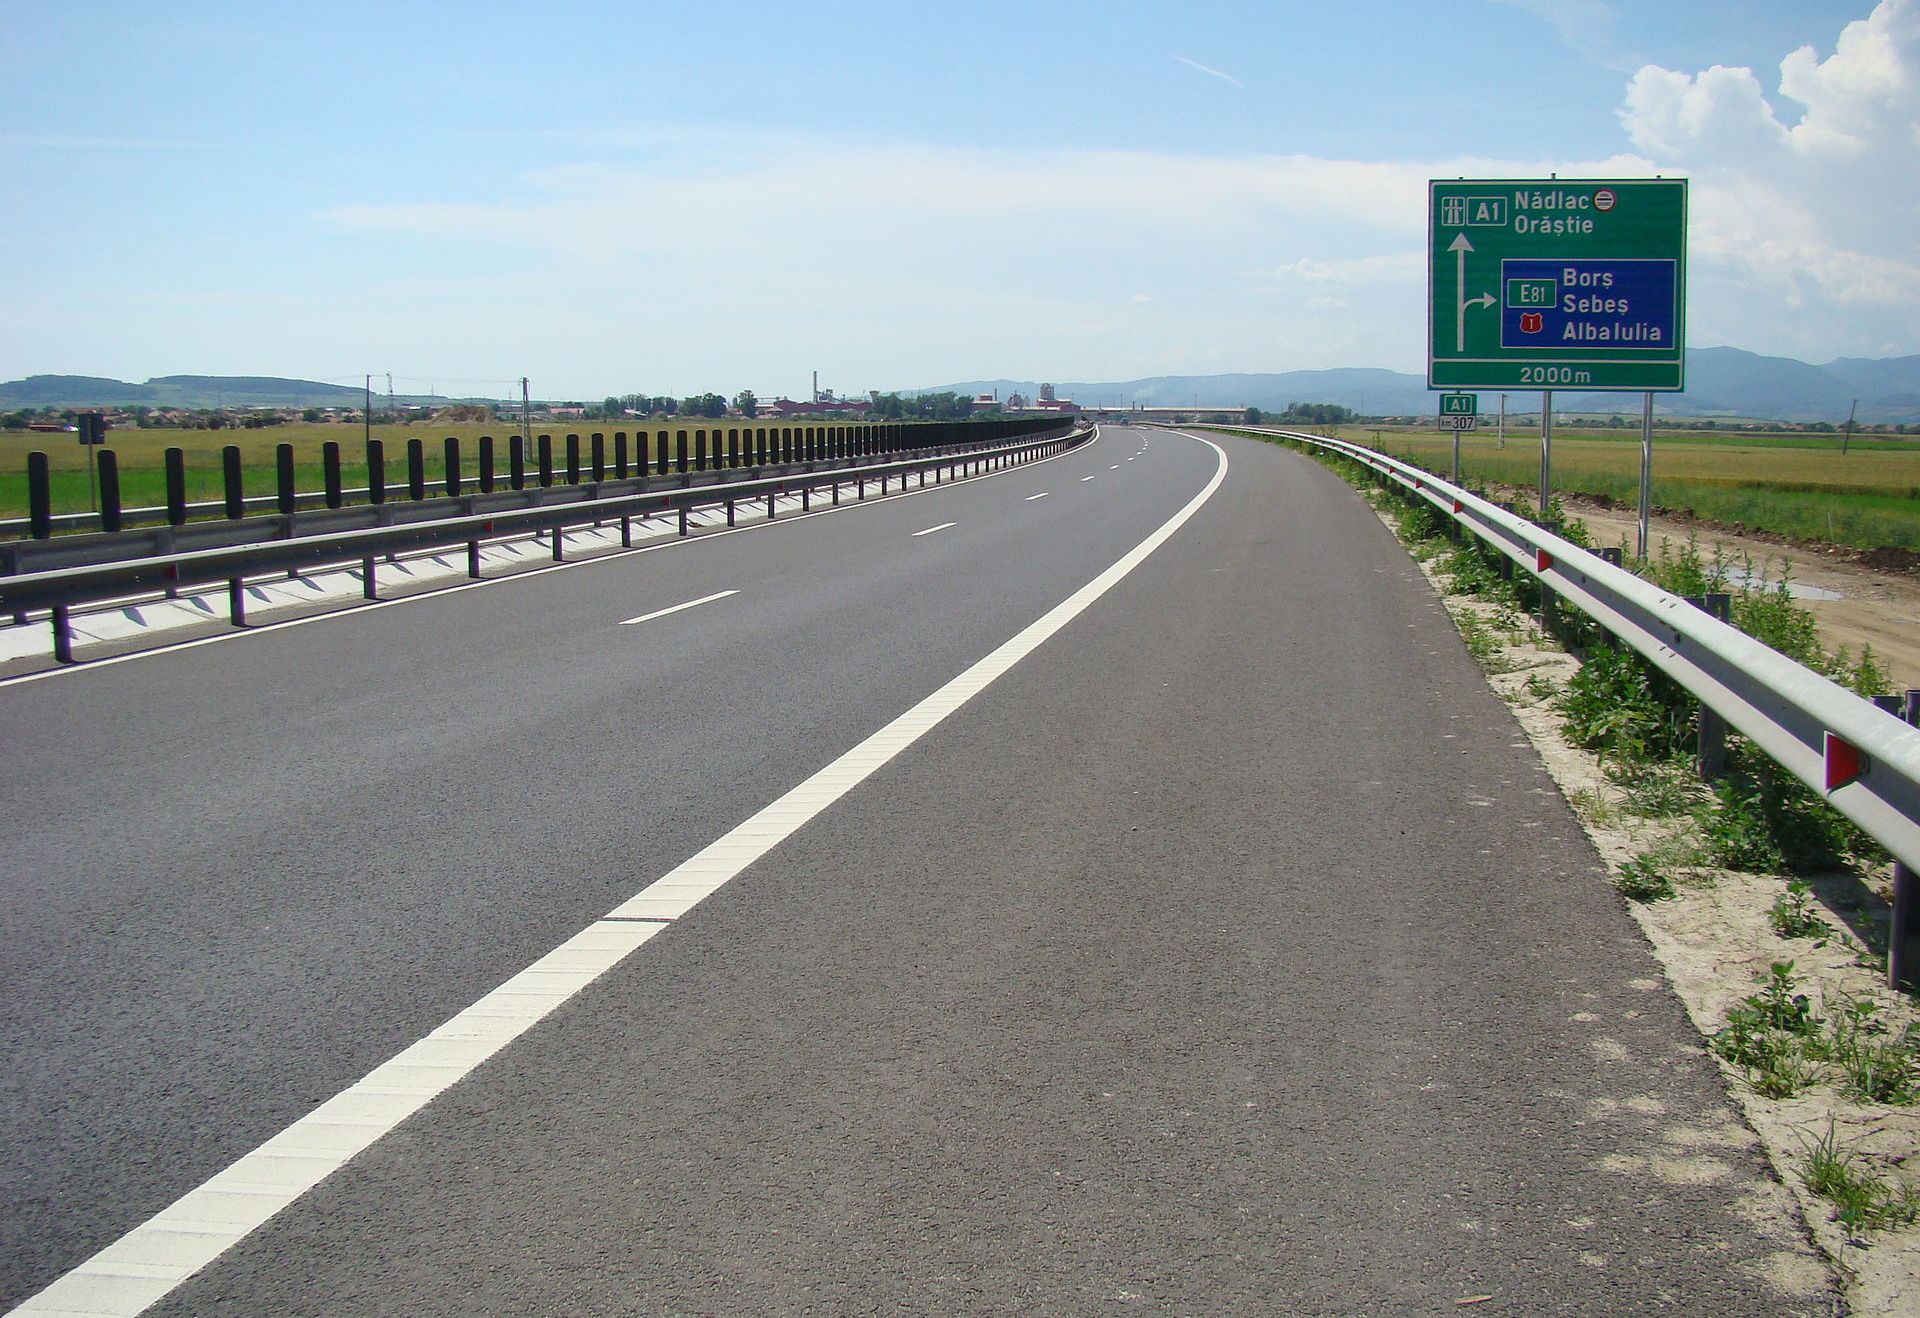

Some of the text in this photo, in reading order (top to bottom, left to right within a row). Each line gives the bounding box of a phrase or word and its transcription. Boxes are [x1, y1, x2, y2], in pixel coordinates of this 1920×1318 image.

[1514, 190, 1590, 211] Nădlac
[1476, 202, 1499, 221] A1
[1520, 284, 1546, 303] E81
[1450, 398, 1467, 411] A1
[1452, 416, 1474, 430] 307
